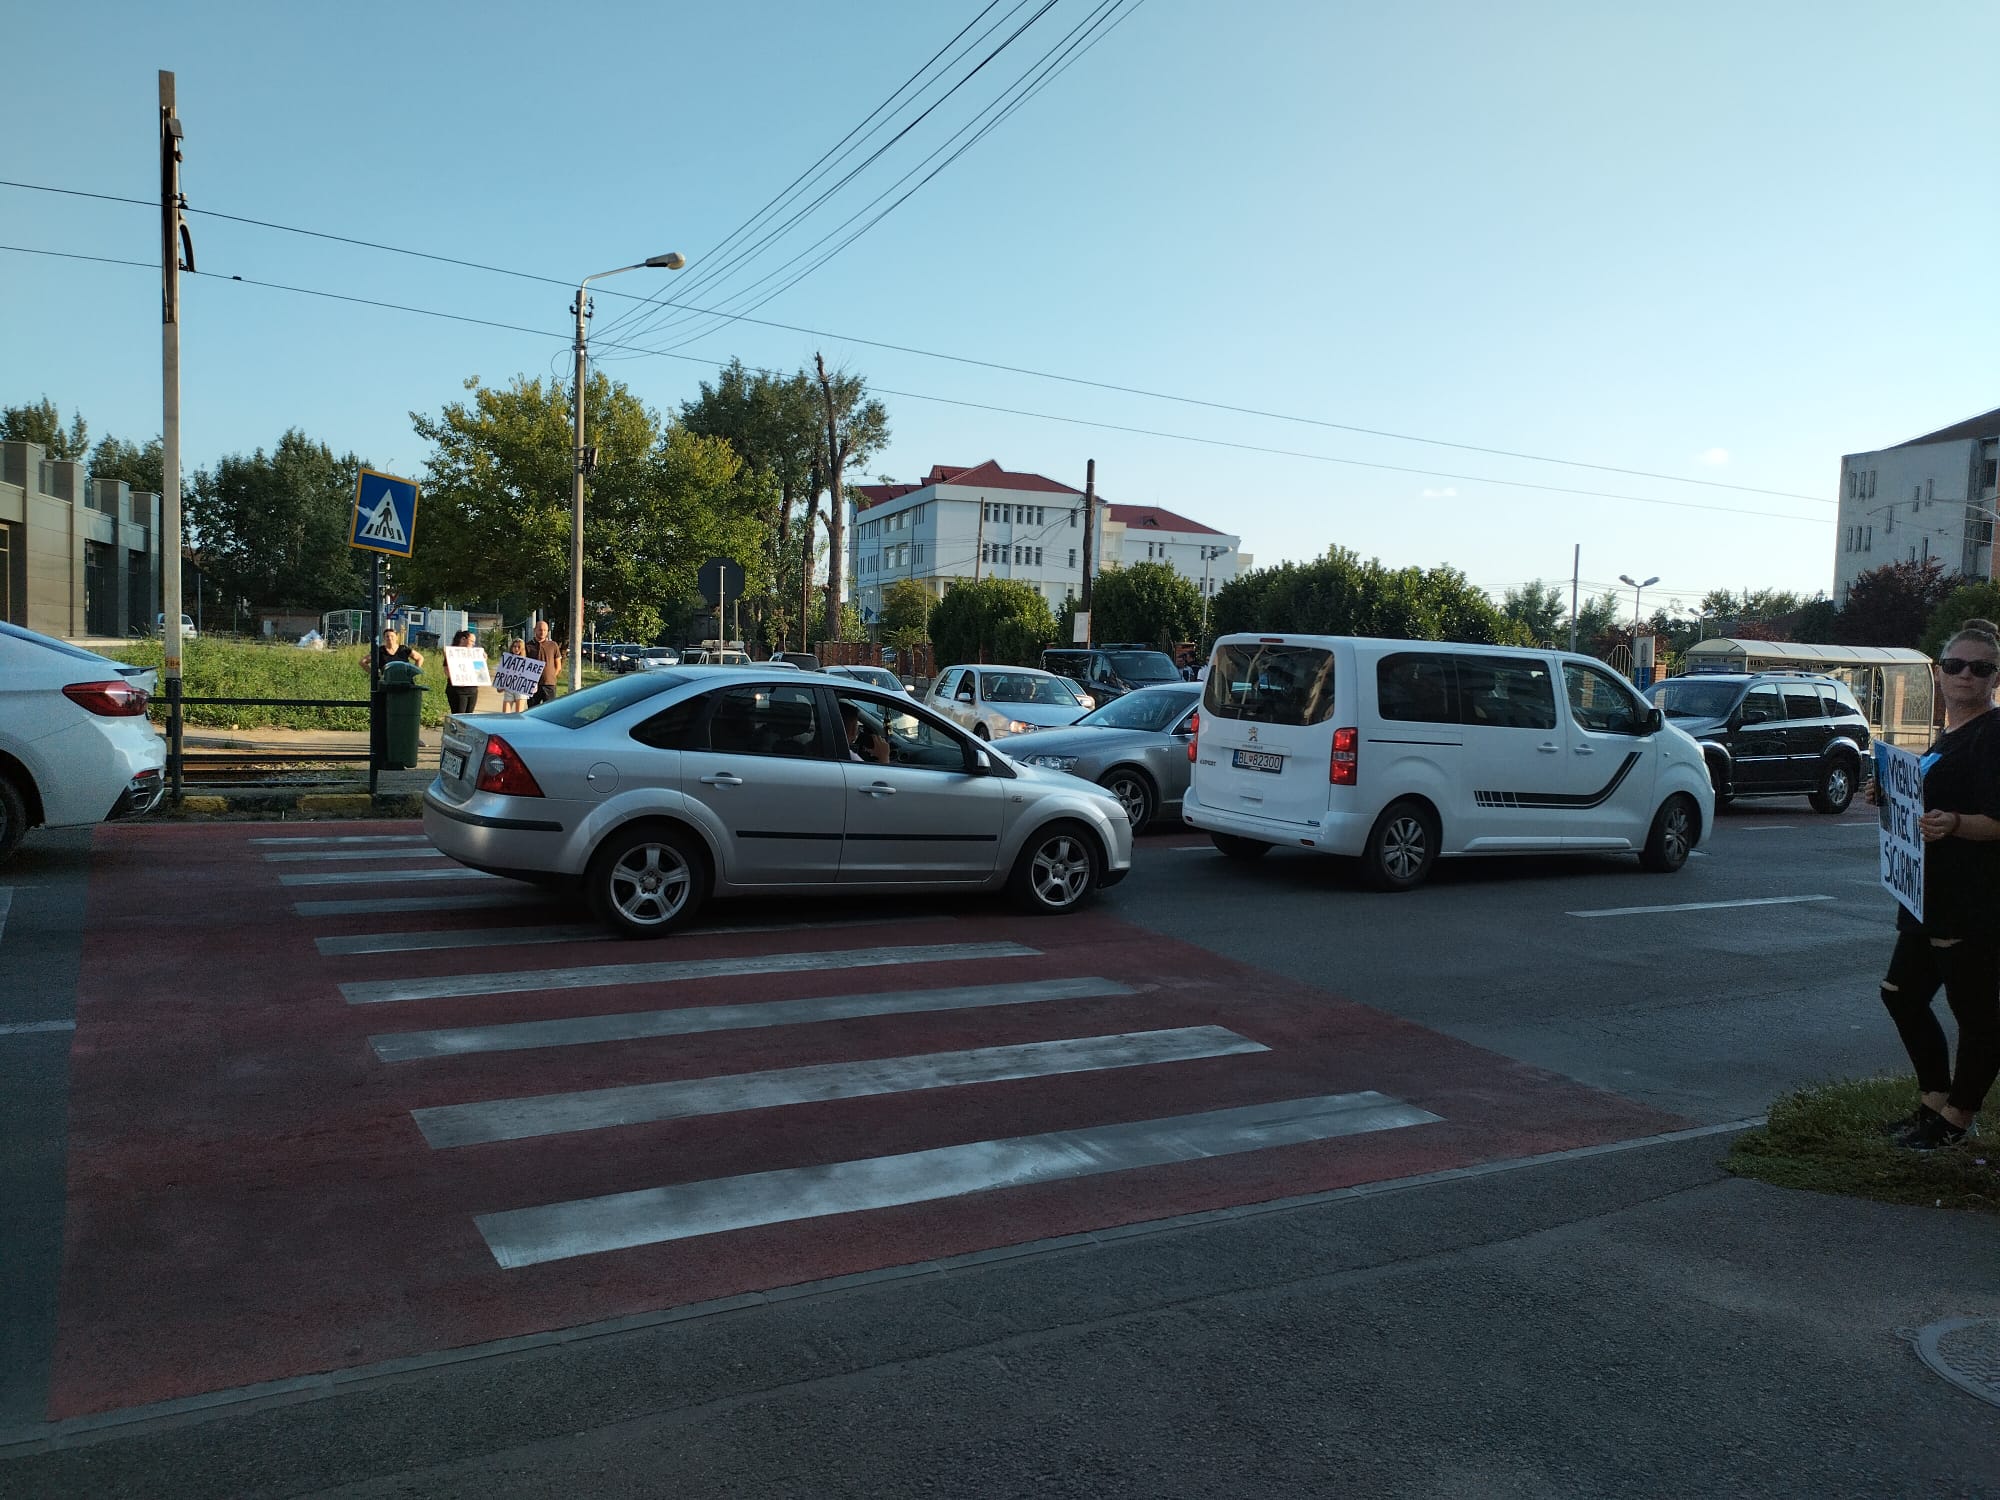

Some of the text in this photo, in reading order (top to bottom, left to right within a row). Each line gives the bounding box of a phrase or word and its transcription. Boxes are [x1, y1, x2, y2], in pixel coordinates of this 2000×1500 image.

[493, 671, 538, 695] PRIORITATE
[526, 662, 544, 674] ARE
[1887, 754, 1913, 799] VREAU
[1891, 797, 1911, 843] TREC
